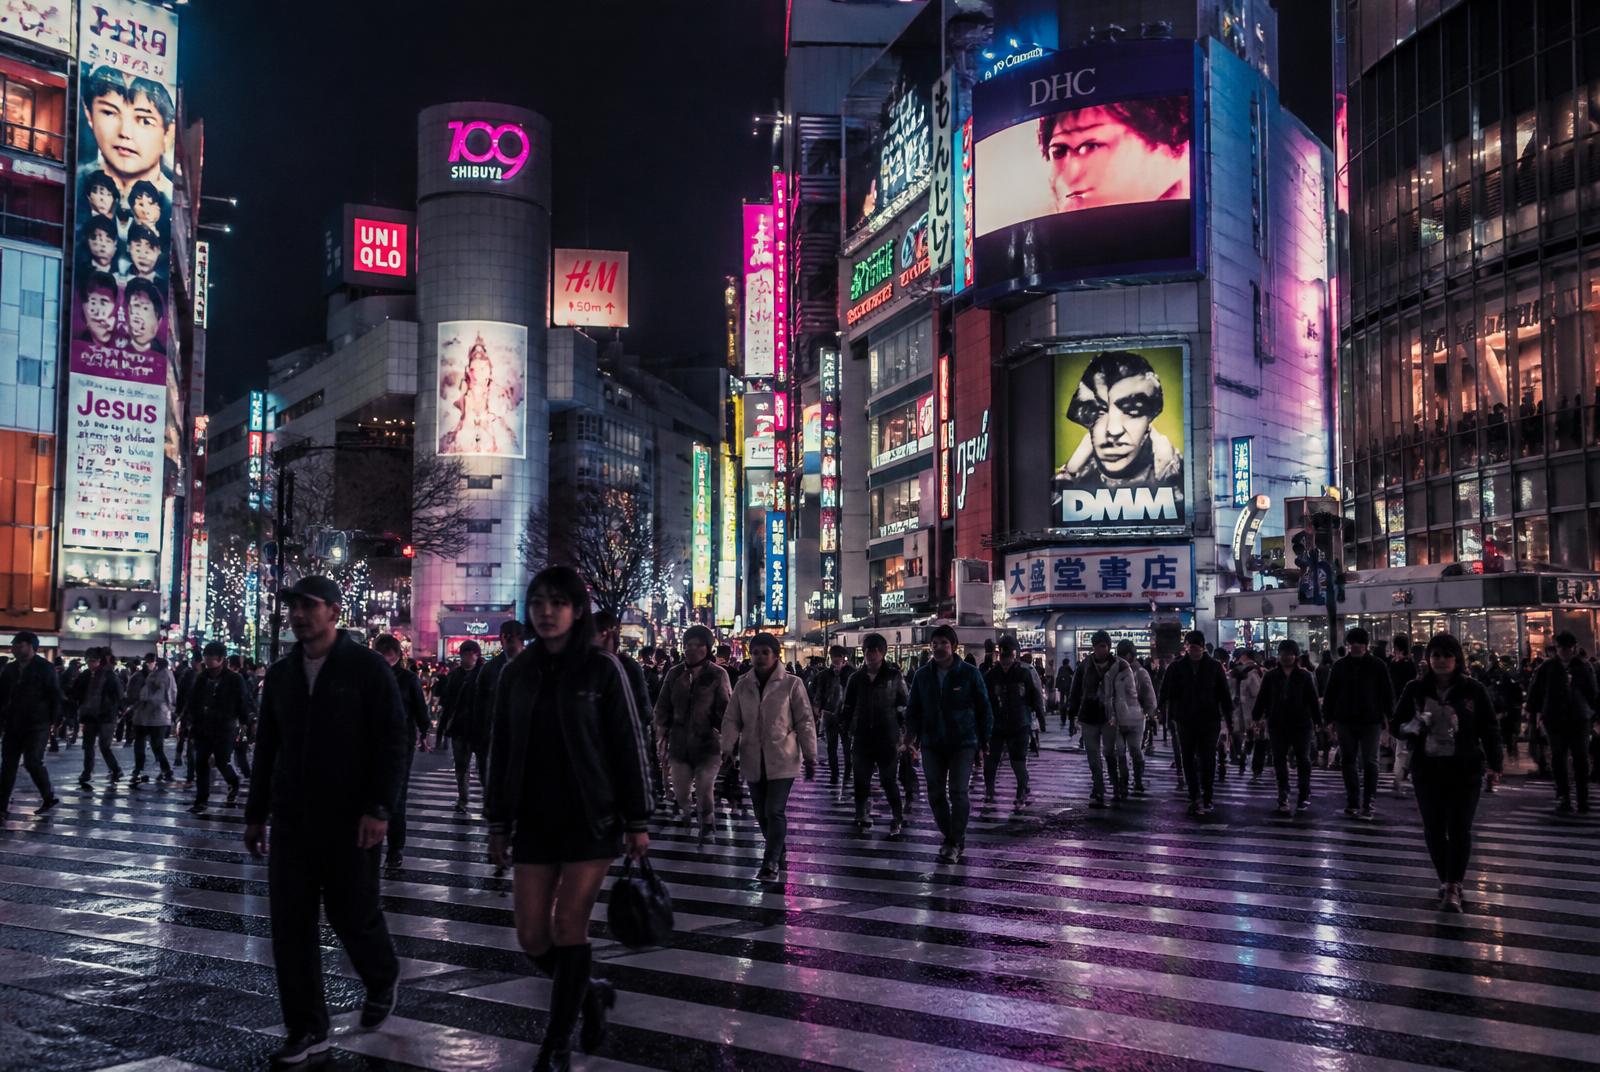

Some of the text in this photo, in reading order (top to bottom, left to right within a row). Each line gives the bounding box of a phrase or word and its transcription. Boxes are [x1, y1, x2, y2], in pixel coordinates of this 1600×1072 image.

[1029, 68, 1096, 107] DHC
[448, 121, 530, 180] 109
[451, 166, 502, 180] SHIBUYA
[361, 225, 398, 248] UNI
[360, 246, 402, 269] QLO
[565, 260, 618, 293] H&M
[576, 302, 602, 312] 50m
[77, 390, 158, 424] Jesus
[1062, 487, 1178, 522] DMM
[1009, 554, 1178, 595] 大盛堂書店
